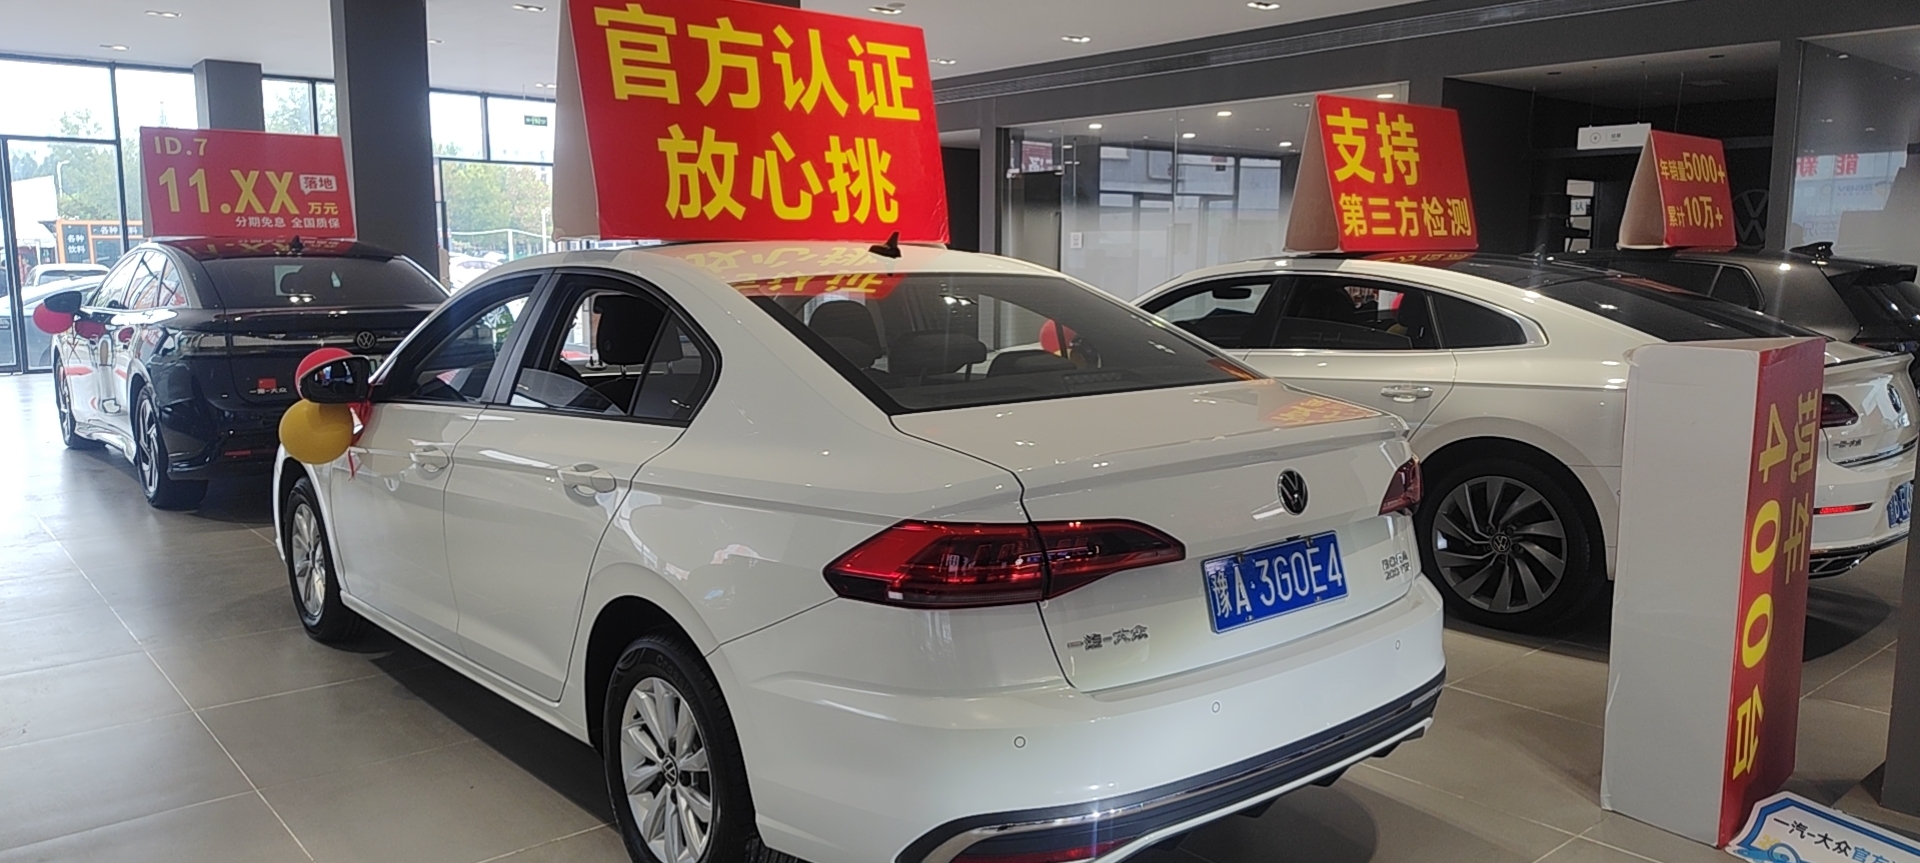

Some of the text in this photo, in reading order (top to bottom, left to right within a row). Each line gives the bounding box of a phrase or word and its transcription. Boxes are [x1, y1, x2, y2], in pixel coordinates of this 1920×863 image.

[594, 3, 921, 121] 官方认证
[154, 136, 208, 156] ID.7
[1326, 107, 1421, 187] 支持
[303, 176, 334, 190] 落地
[657, 124, 899, 224] 放心挑
[1659, 152, 1726, 184] 年销量5000+
[159, 167, 300, 215] 11.XX
[308, 202, 339, 215] 万元
[100, 226, 138, 235] 各种料
[235, 216, 340, 229] 分期免息 全国质保
[1338, 193, 1473, 238] 第三方检测
[1667, 195, 1724, 230] 累计10万+
[1783, 388, 1819, 585] 现车
[1732, 403, 1789, 781] 400台
